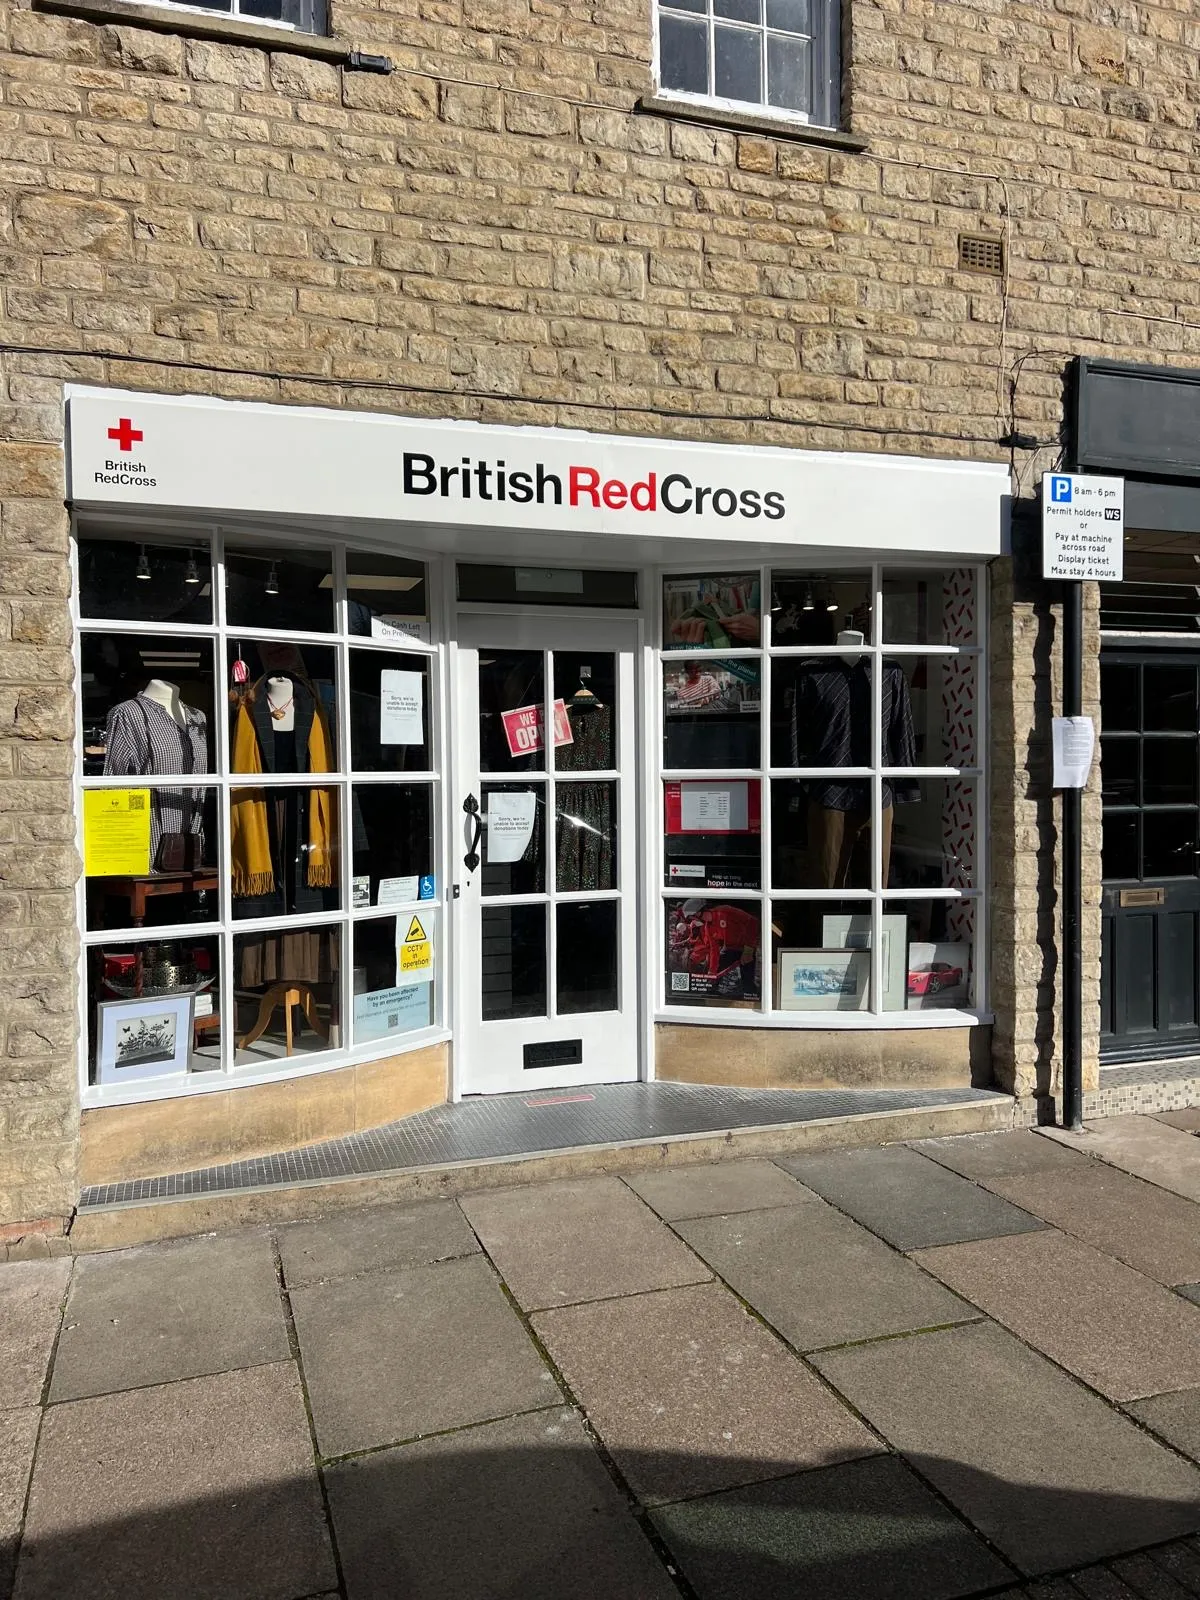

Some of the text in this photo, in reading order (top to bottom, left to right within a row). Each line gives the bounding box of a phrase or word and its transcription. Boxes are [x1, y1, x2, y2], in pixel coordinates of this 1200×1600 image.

[105, 460, 146, 473] British
[94, 472, 157, 487] RedCross
[1074, 487, 1080, 495] 8
[1104, 490, 1116, 498] pm
[1046, 506, 1120, 520] Permit holders WS
[1055, 532, 1069, 542] Pay
[1081, 535, 1113, 543] machine
[1062, 544, 1087, 552] across
[1058, 554, 1110, 565] Display ticket
[1051, 566, 1116, 577] Max stay 4 hours
[381, 628, 391, 636] On
[707, 879, 725, 887] hope
[407, 944, 424, 953] CCTV
[402, 958, 429, 969] operation
[400, 986, 419, 995] affected
[386, 993, 413, 1006] emergency?
